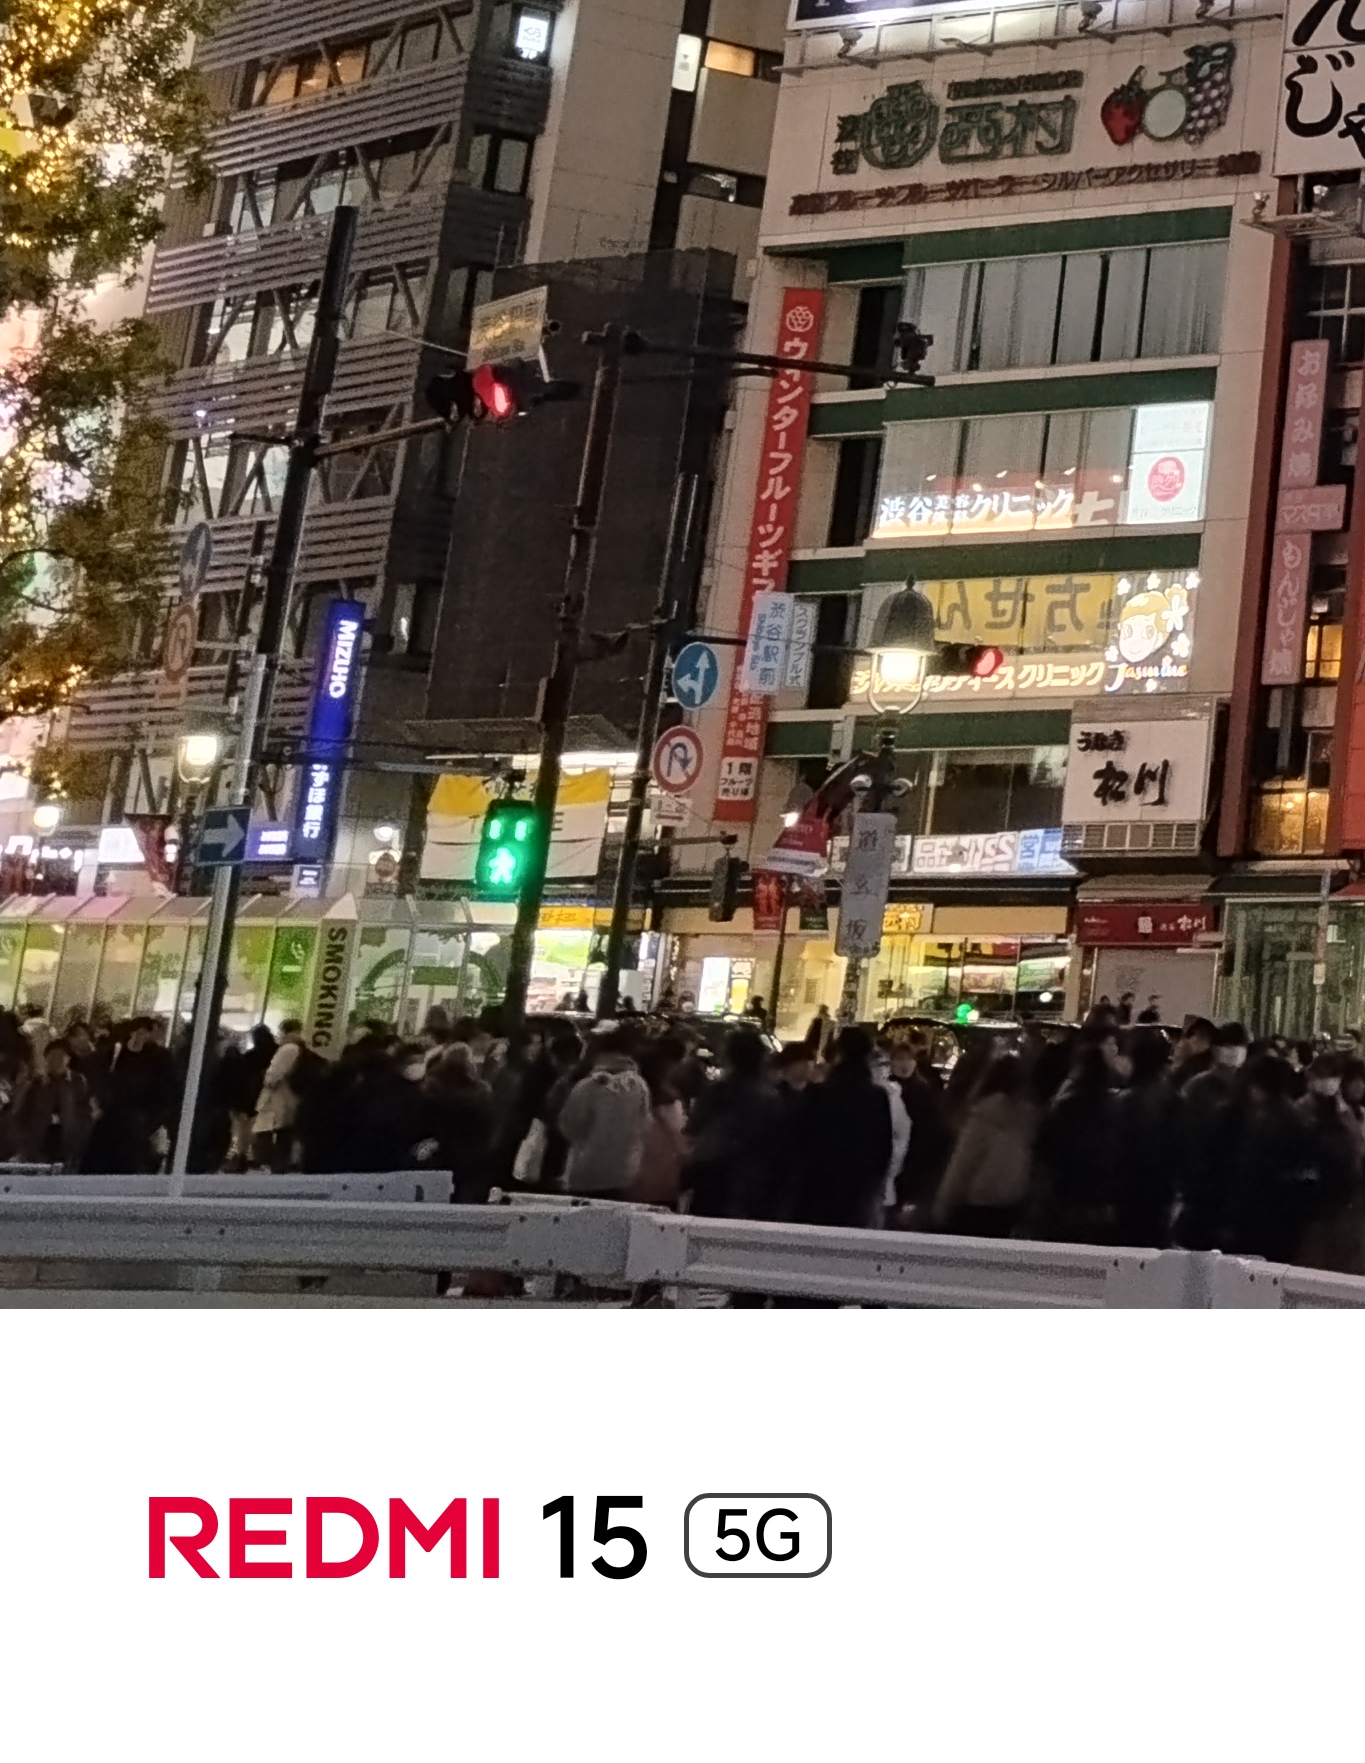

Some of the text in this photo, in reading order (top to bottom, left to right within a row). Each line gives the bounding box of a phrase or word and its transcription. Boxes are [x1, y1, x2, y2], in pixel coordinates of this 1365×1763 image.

[747, 336, 809, 597] ウィンターフルーツギフ
[329, 620, 358, 698] MIZUHO
[758, 601, 787, 686] 渋谷駅前
[1104, 661, 1189, 692] Jasmine
[1093, 759, 1170, 807] 松川
[313, 926, 349, 1050] SMOKING
